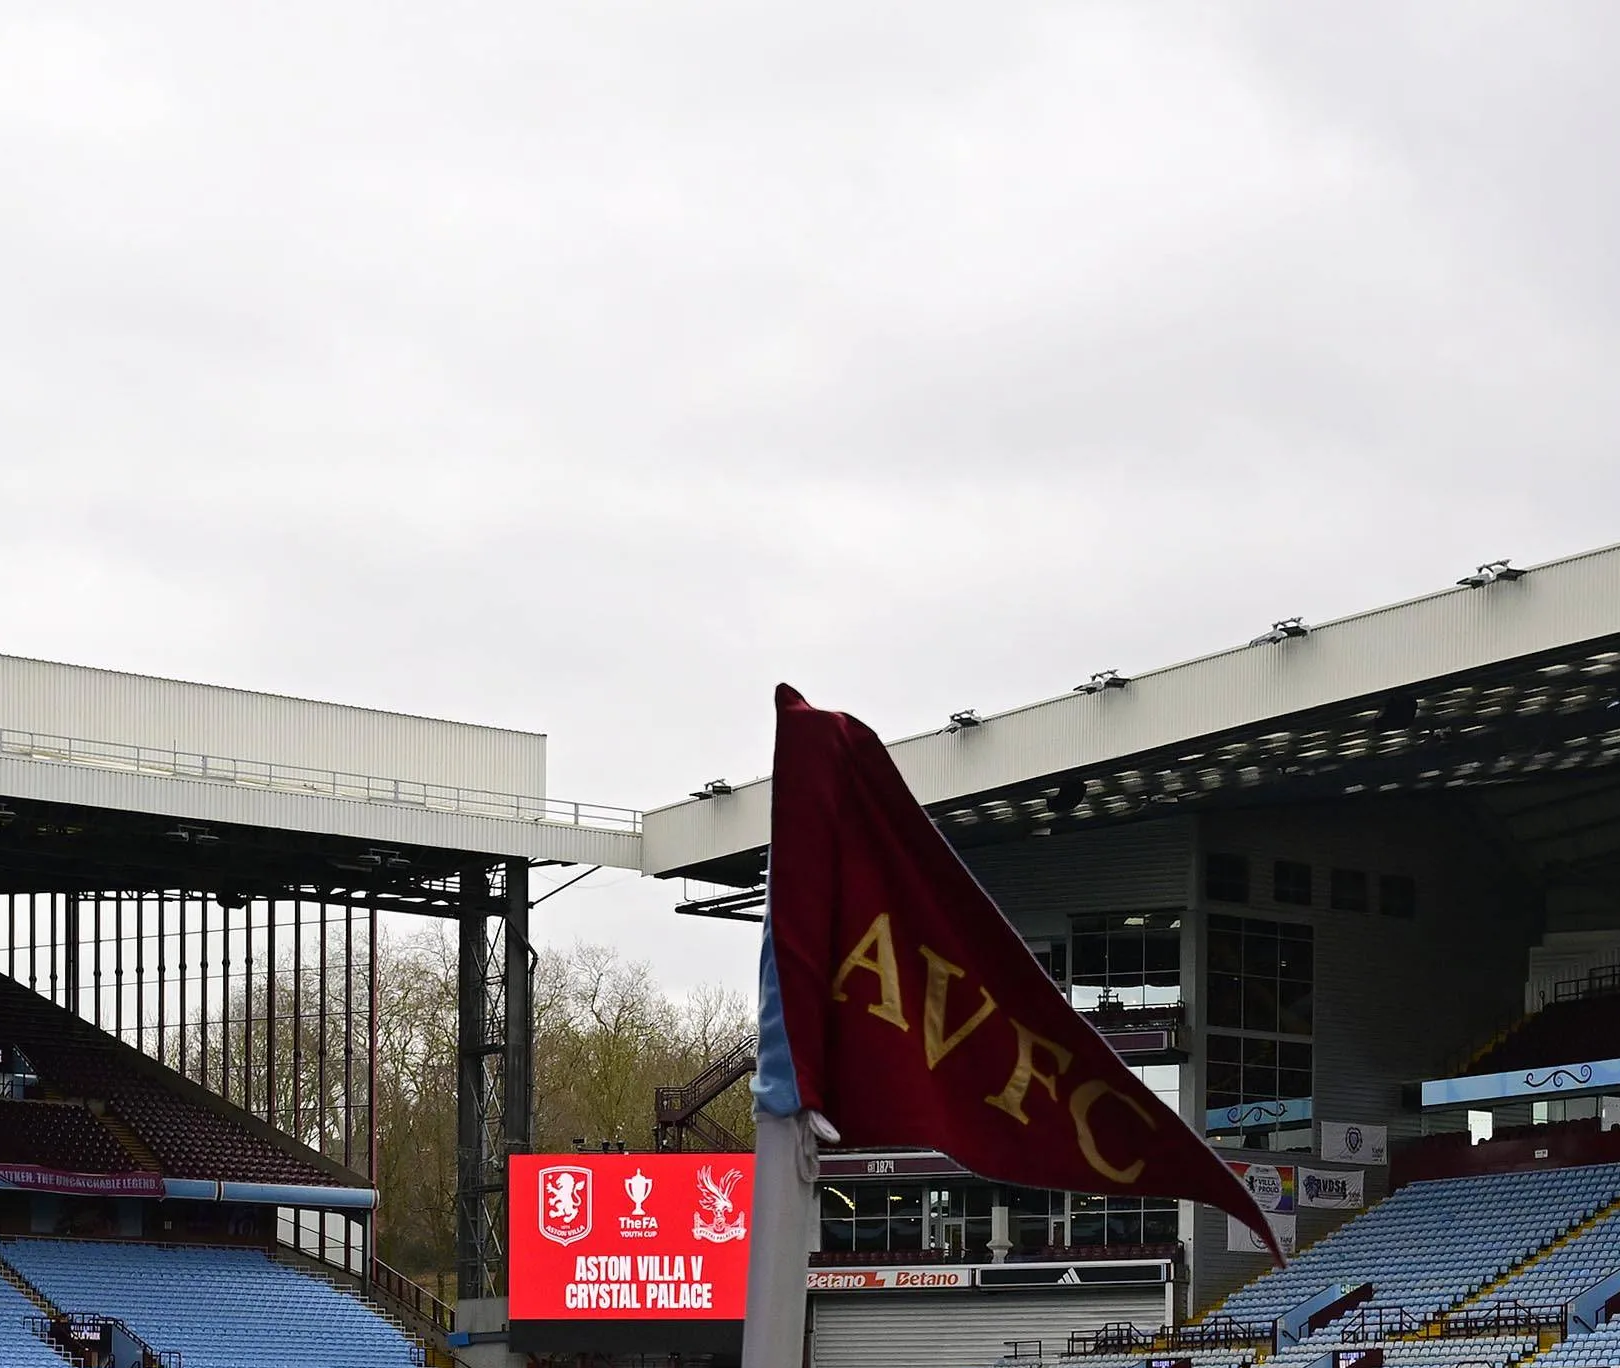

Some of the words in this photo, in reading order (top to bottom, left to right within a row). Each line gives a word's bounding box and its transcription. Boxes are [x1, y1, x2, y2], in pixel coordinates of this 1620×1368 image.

[832, 912, 1157, 1183] AVFC
[620, 1230, 643, 1238] YOUTH
[575, 1256, 630, 1281] ASTON
[637, 1256, 685, 1281] VILLA
[691, 1256, 703, 1281] V
[807, 1273, 866, 1288] Betano
[896, 1272, 959, 1286] Betano
[565, 1283, 641, 1309] CRYSTAL
[646, 1283, 713, 1309] PALACE
